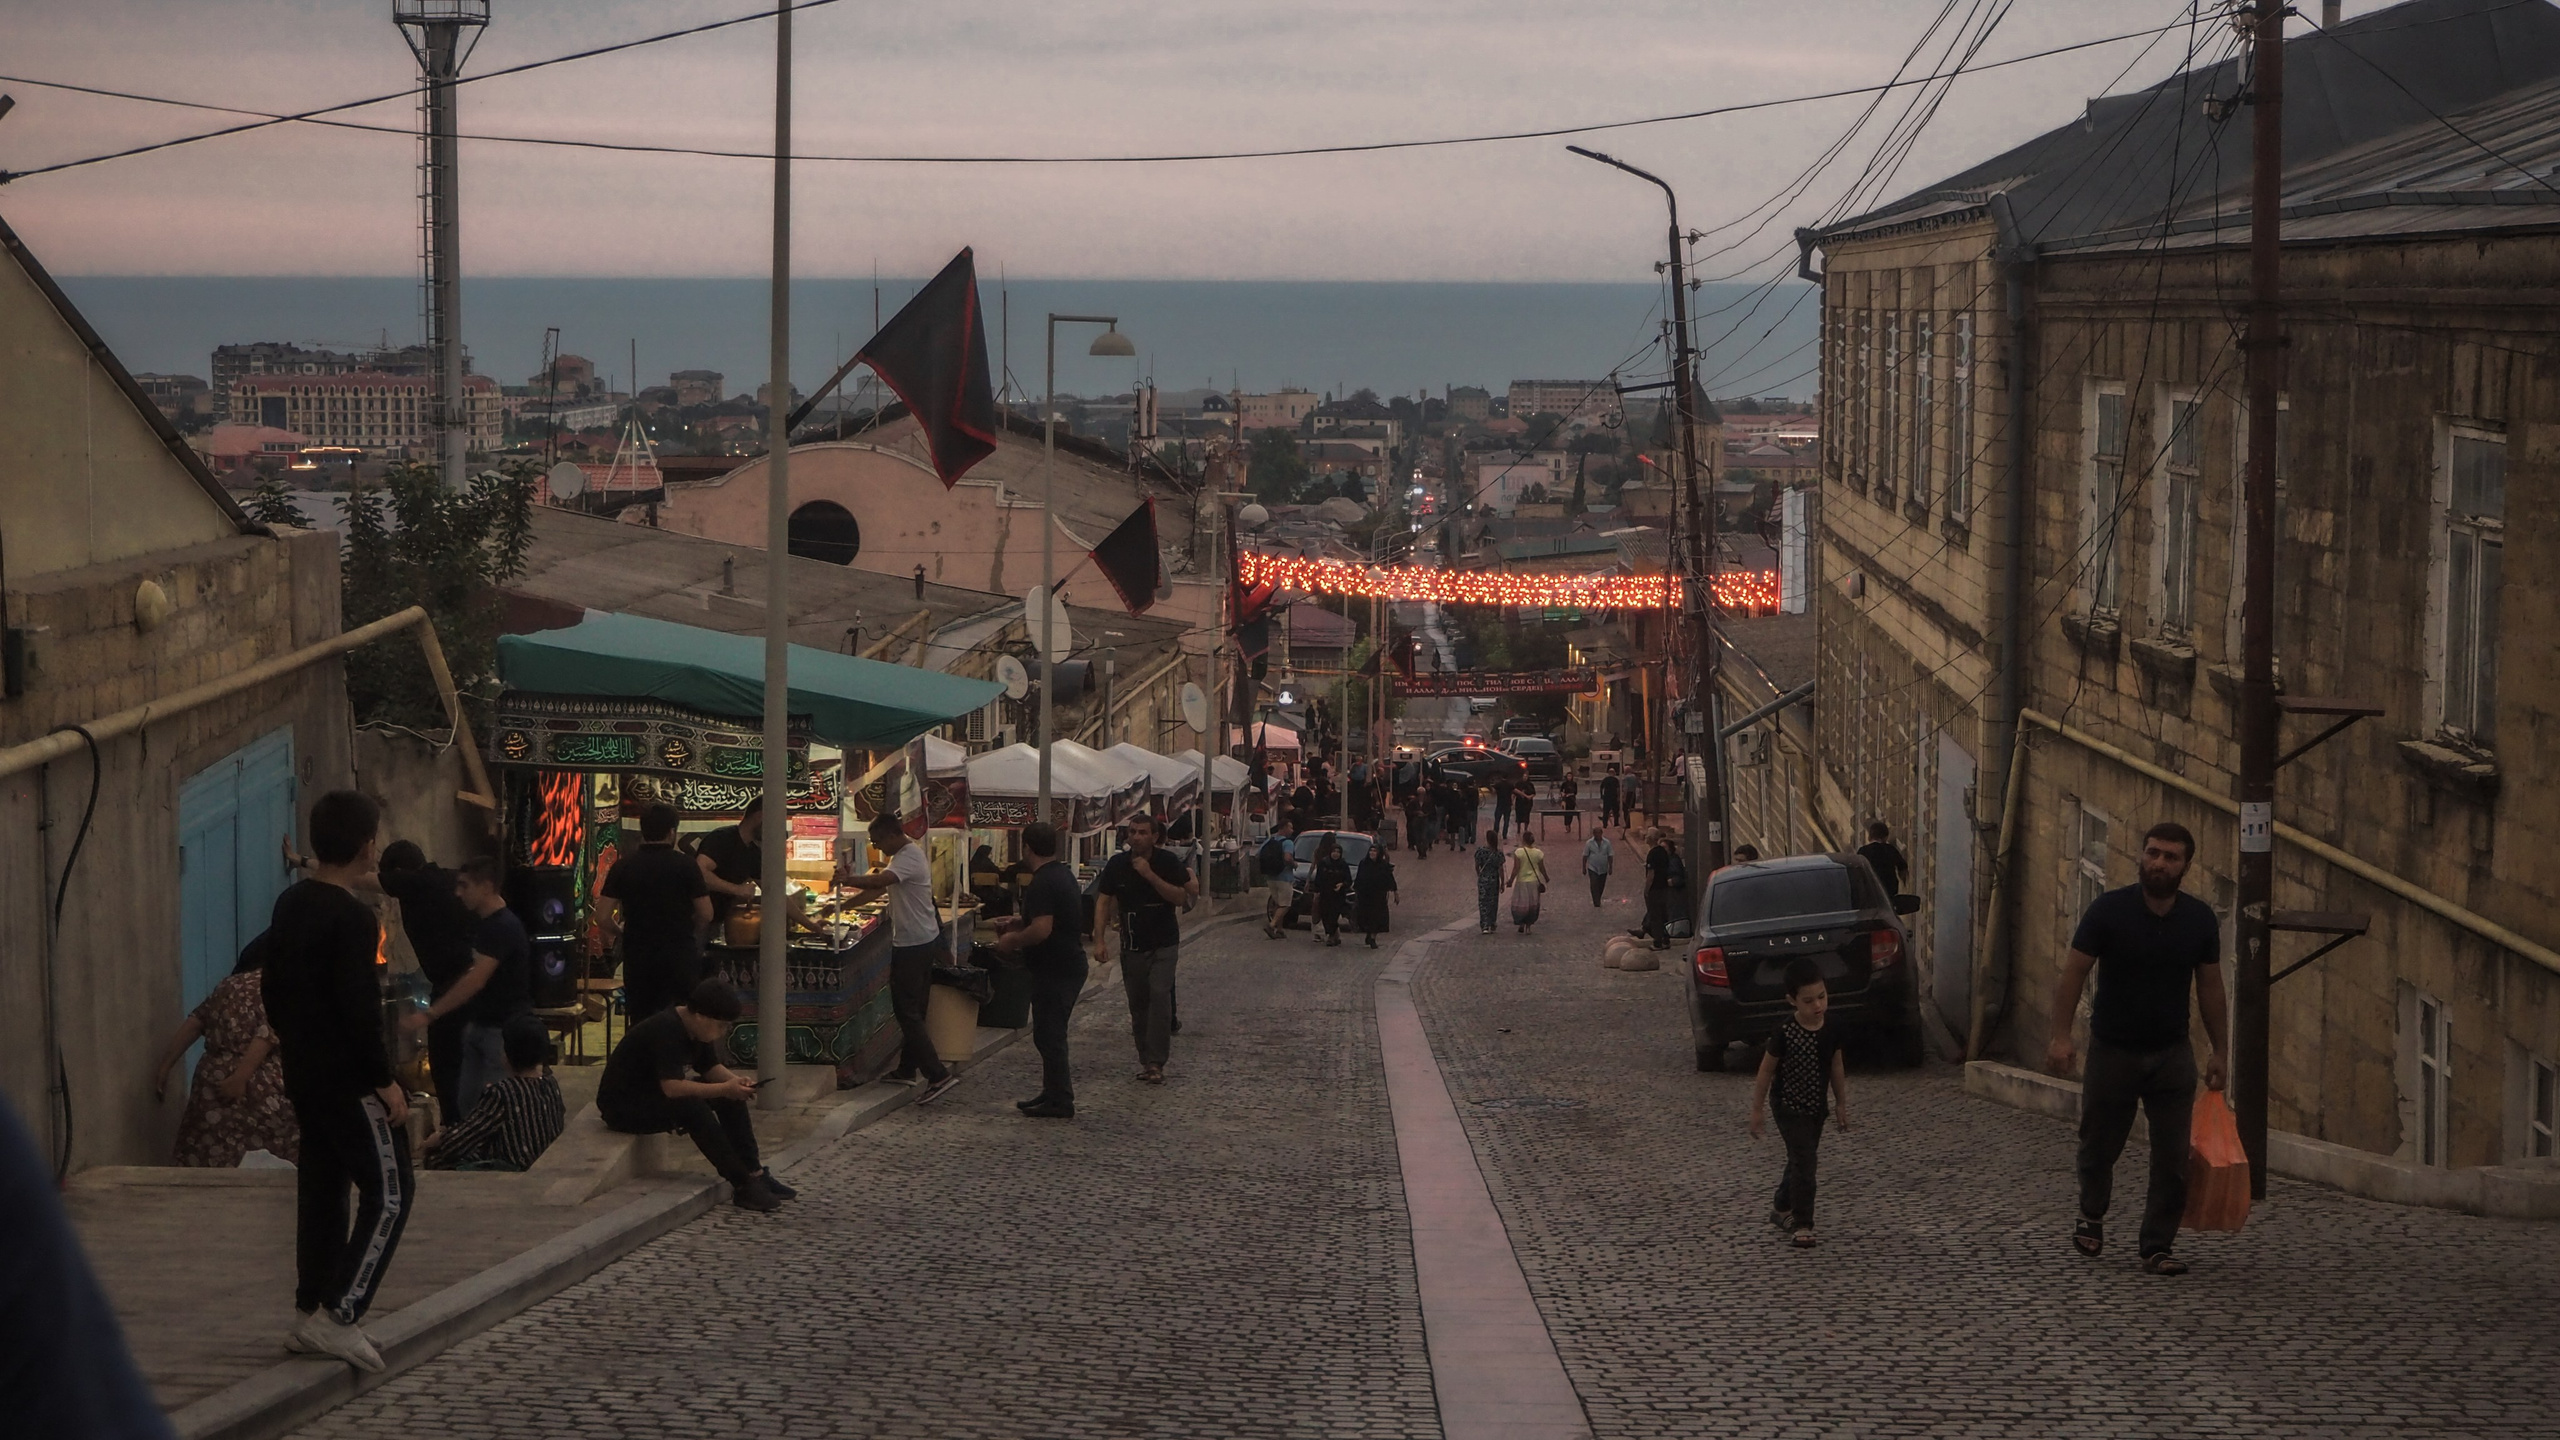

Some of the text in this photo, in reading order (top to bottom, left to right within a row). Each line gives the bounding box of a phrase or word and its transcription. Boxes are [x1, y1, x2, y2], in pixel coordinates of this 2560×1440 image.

[1769, 934, 1825, 946] LADA
[375, 1117, 390, 1146] PUMA
[388, 1168, 399, 1196] PUMA
[379, 1211, 397, 1238] PUMA
[356, 1262, 374, 1289] PUMA
